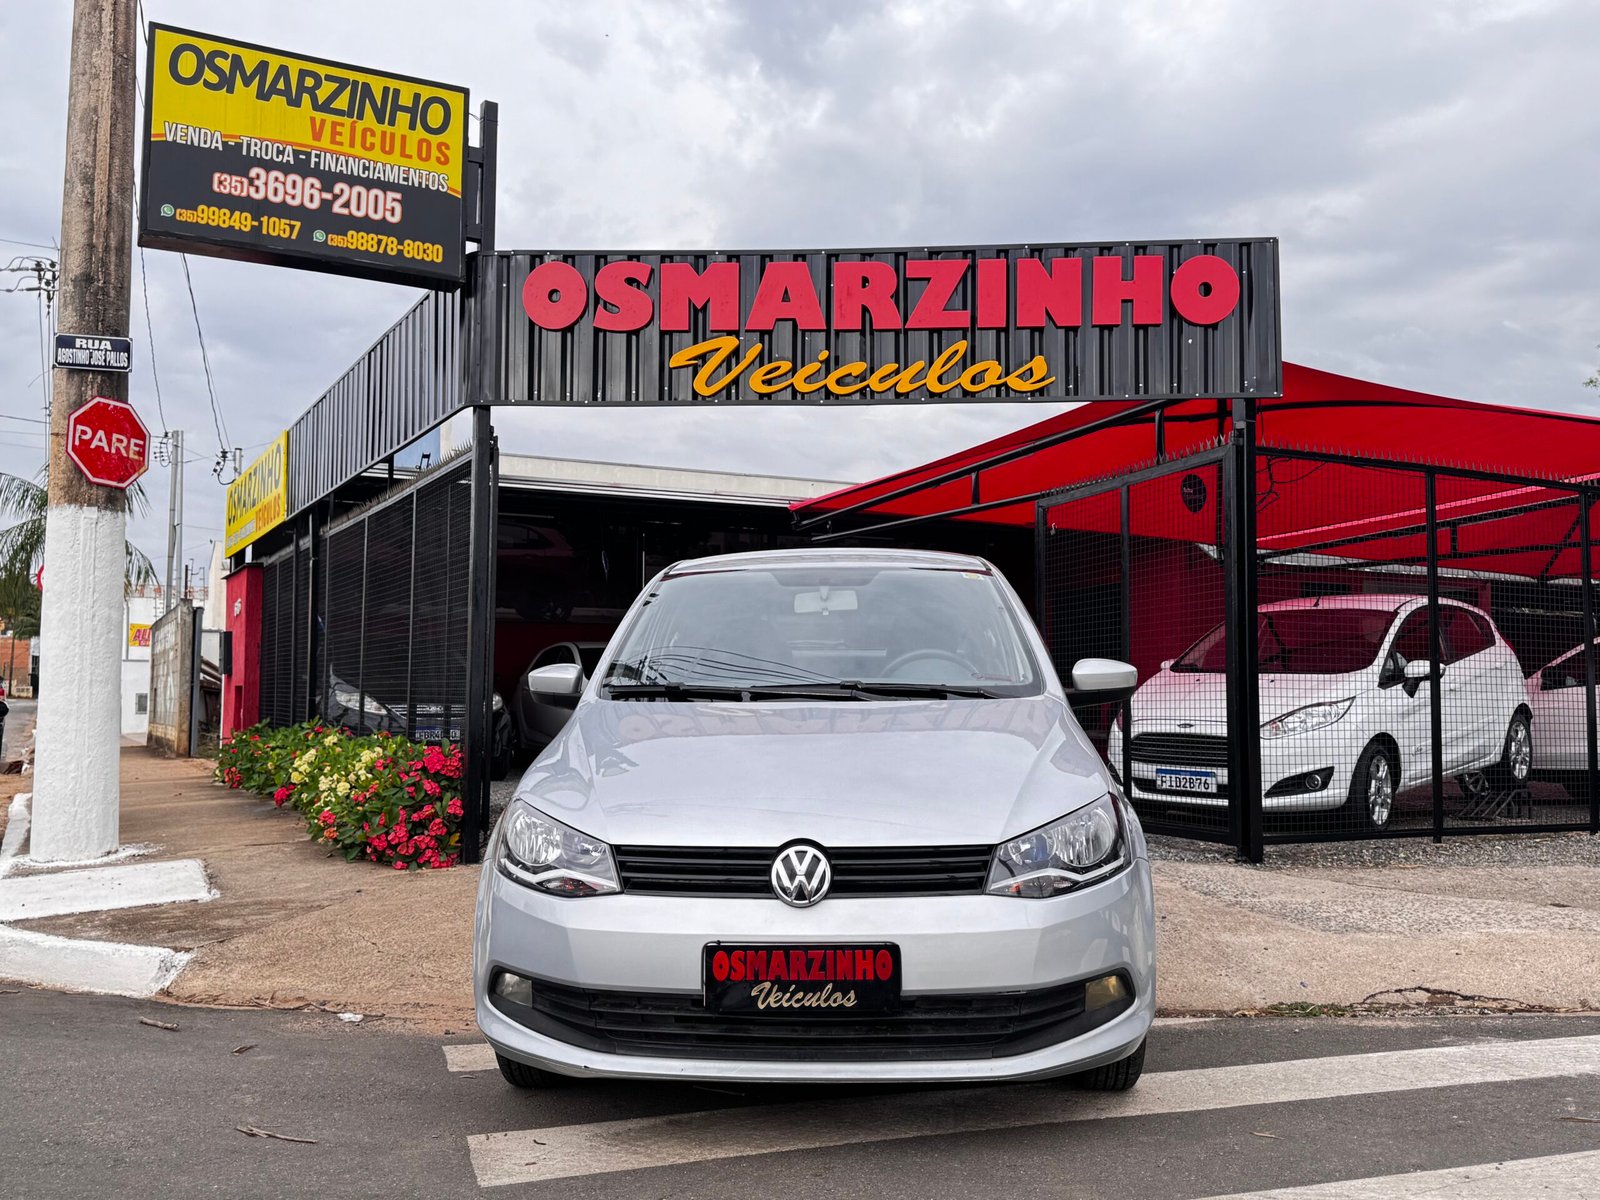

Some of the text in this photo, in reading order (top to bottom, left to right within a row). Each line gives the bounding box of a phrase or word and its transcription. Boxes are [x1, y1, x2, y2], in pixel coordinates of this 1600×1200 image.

[169, 43, 451, 135] OSMARZINHO
[163, 121, 223, 151] VENDA
[239, 135, 295, 165] TROCA
[310, 149, 449, 193] FINANCIAMENTOS
[309, 116, 450, 166] VEÍCULOS
[521, 255, 1241, 332] OSMARZINHO
[57, 348, 89, 365] AGOSTINHO
[75, 338, 112, 350] RUA
[669, 335, 1056, 397] Veiculos
[75, 425, 144, 461] PARE
[1160, 775, 1210, 790] FID2B76
[712, 949, 893, 981] OSMARZINHO
